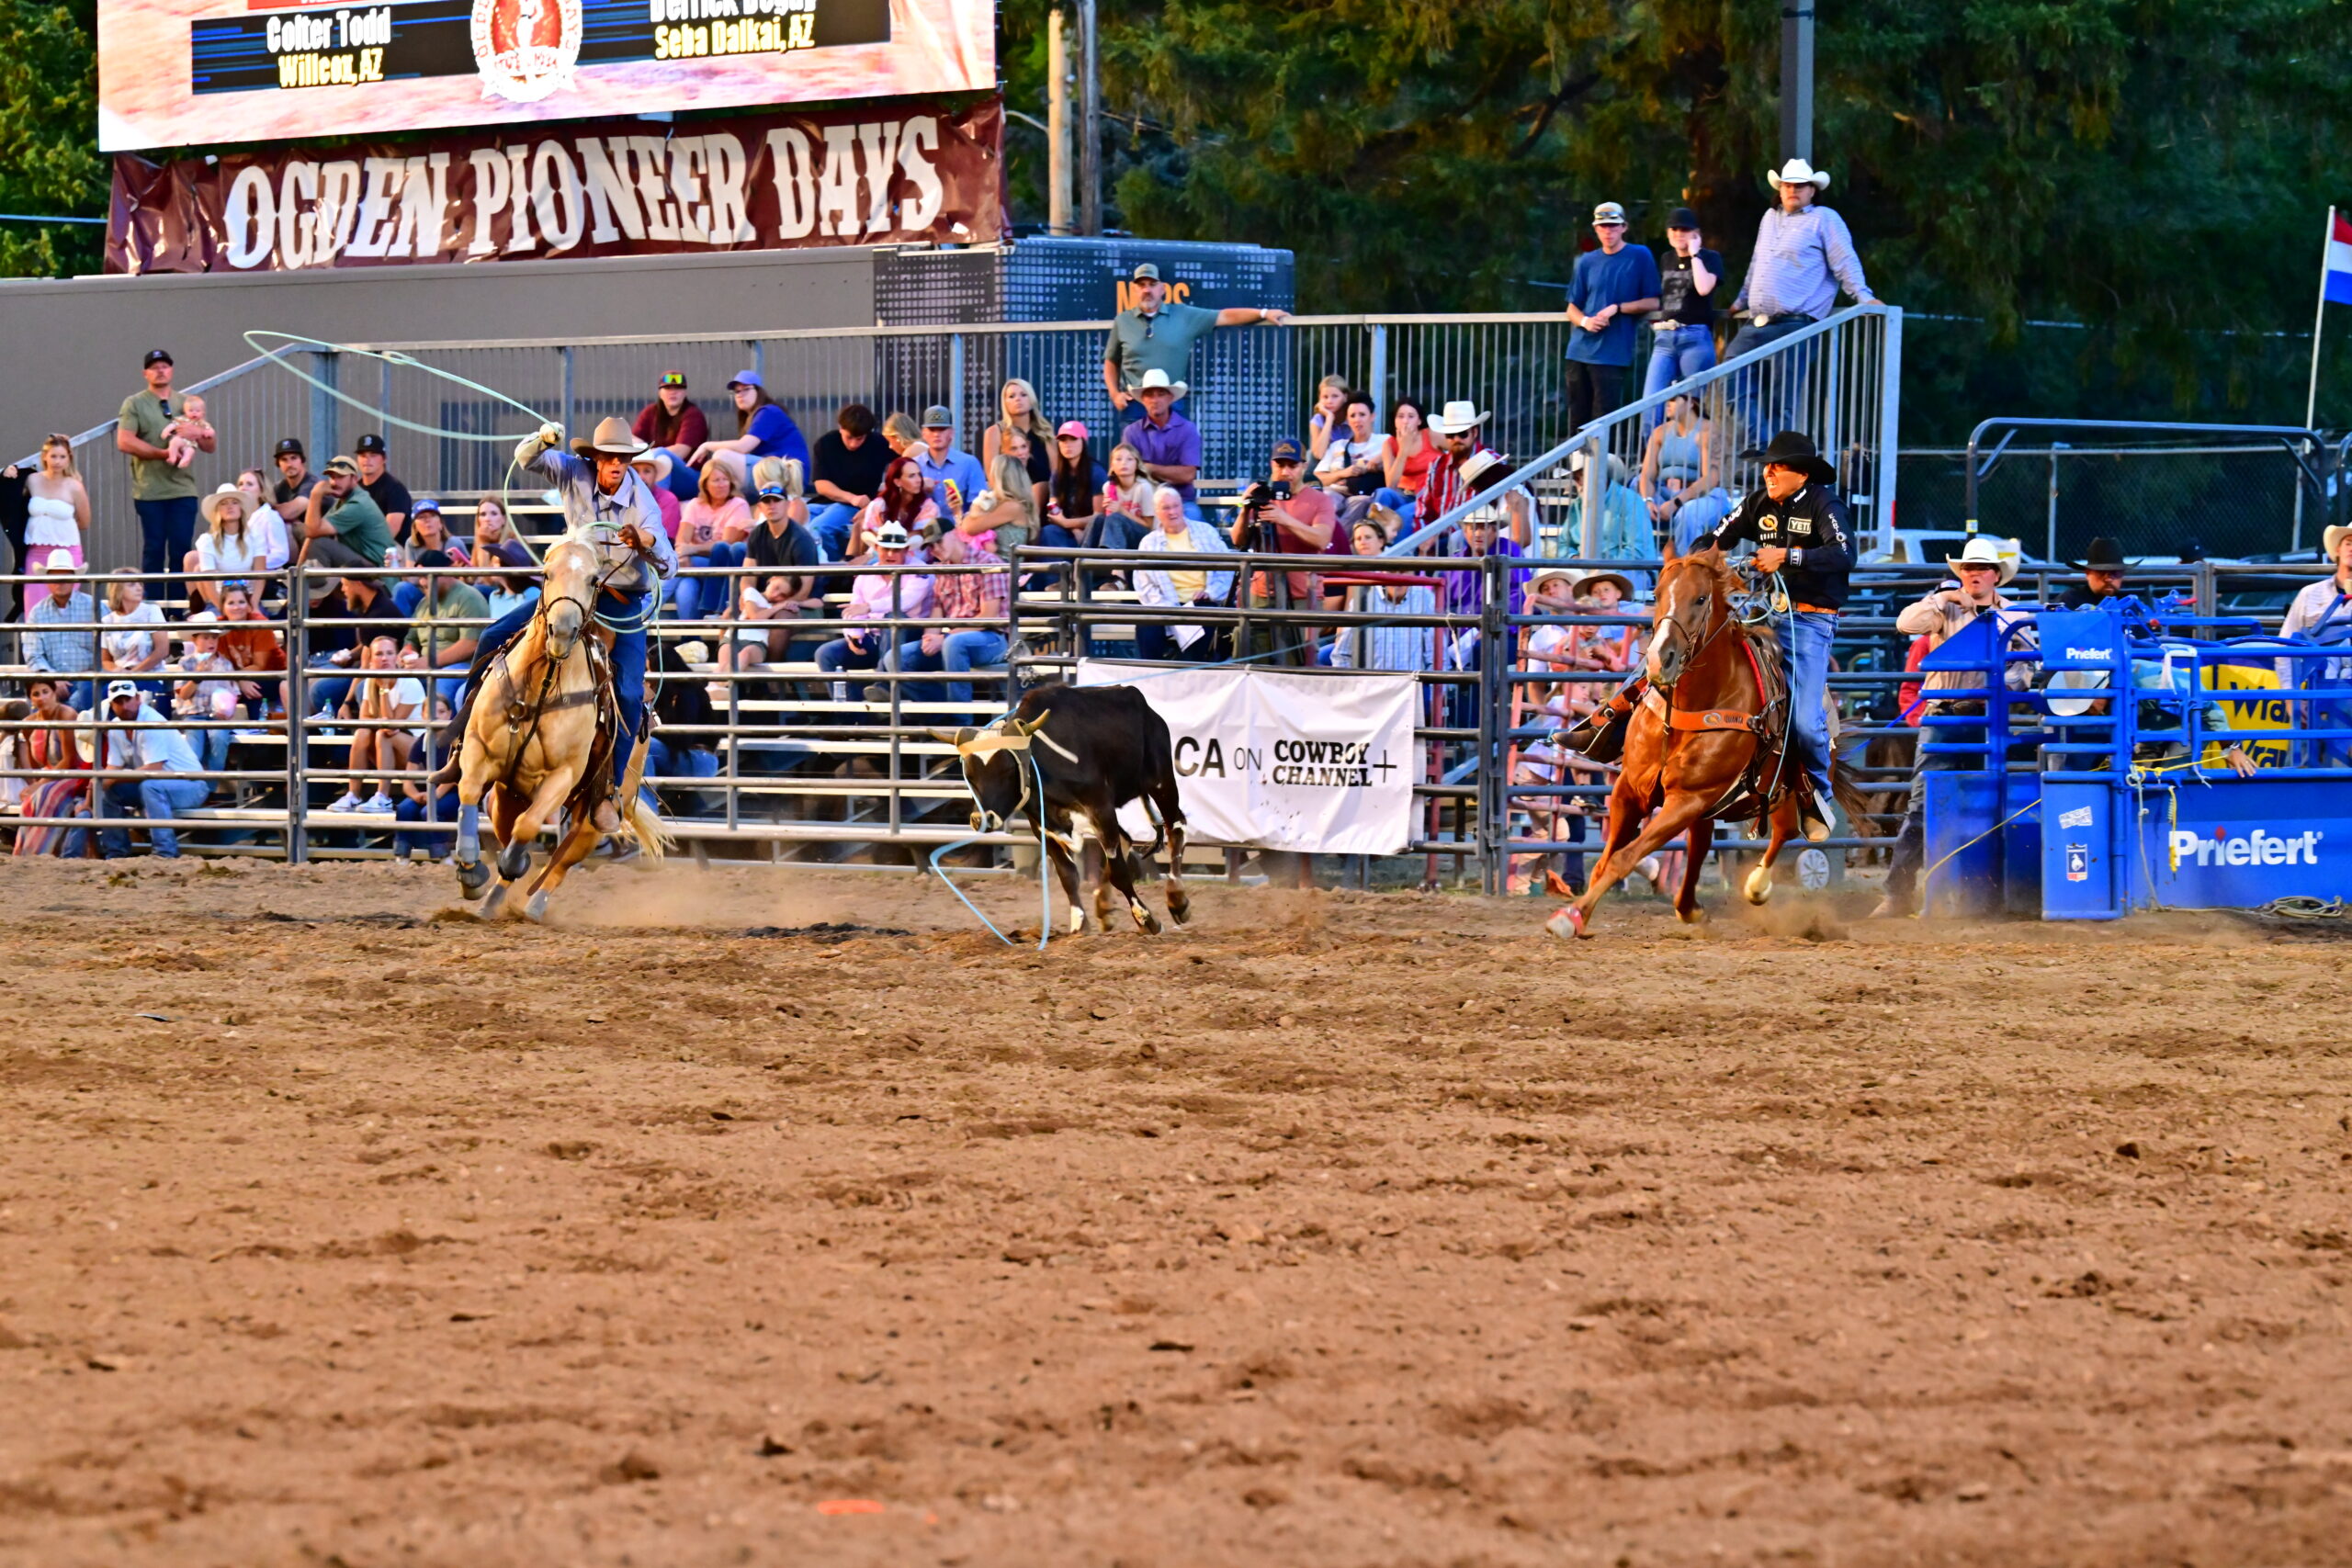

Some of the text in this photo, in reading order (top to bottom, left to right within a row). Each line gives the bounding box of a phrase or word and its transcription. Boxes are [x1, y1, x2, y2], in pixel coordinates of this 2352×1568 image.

[266, 6, 390, 53] Colter Todd
[655, 25, 708, 59] Seba
[223, 116, 944, 269] OGDEN PIONEER DAYS
[1790, 520, 1811, 532] YETI
[2066, 648, 2113, 660] Priefert
[1234, 748, 1262, 772] ON
[1274, 739, 1371, 765] COWBOY
[2168, 827, 2318, 866] Priefert
